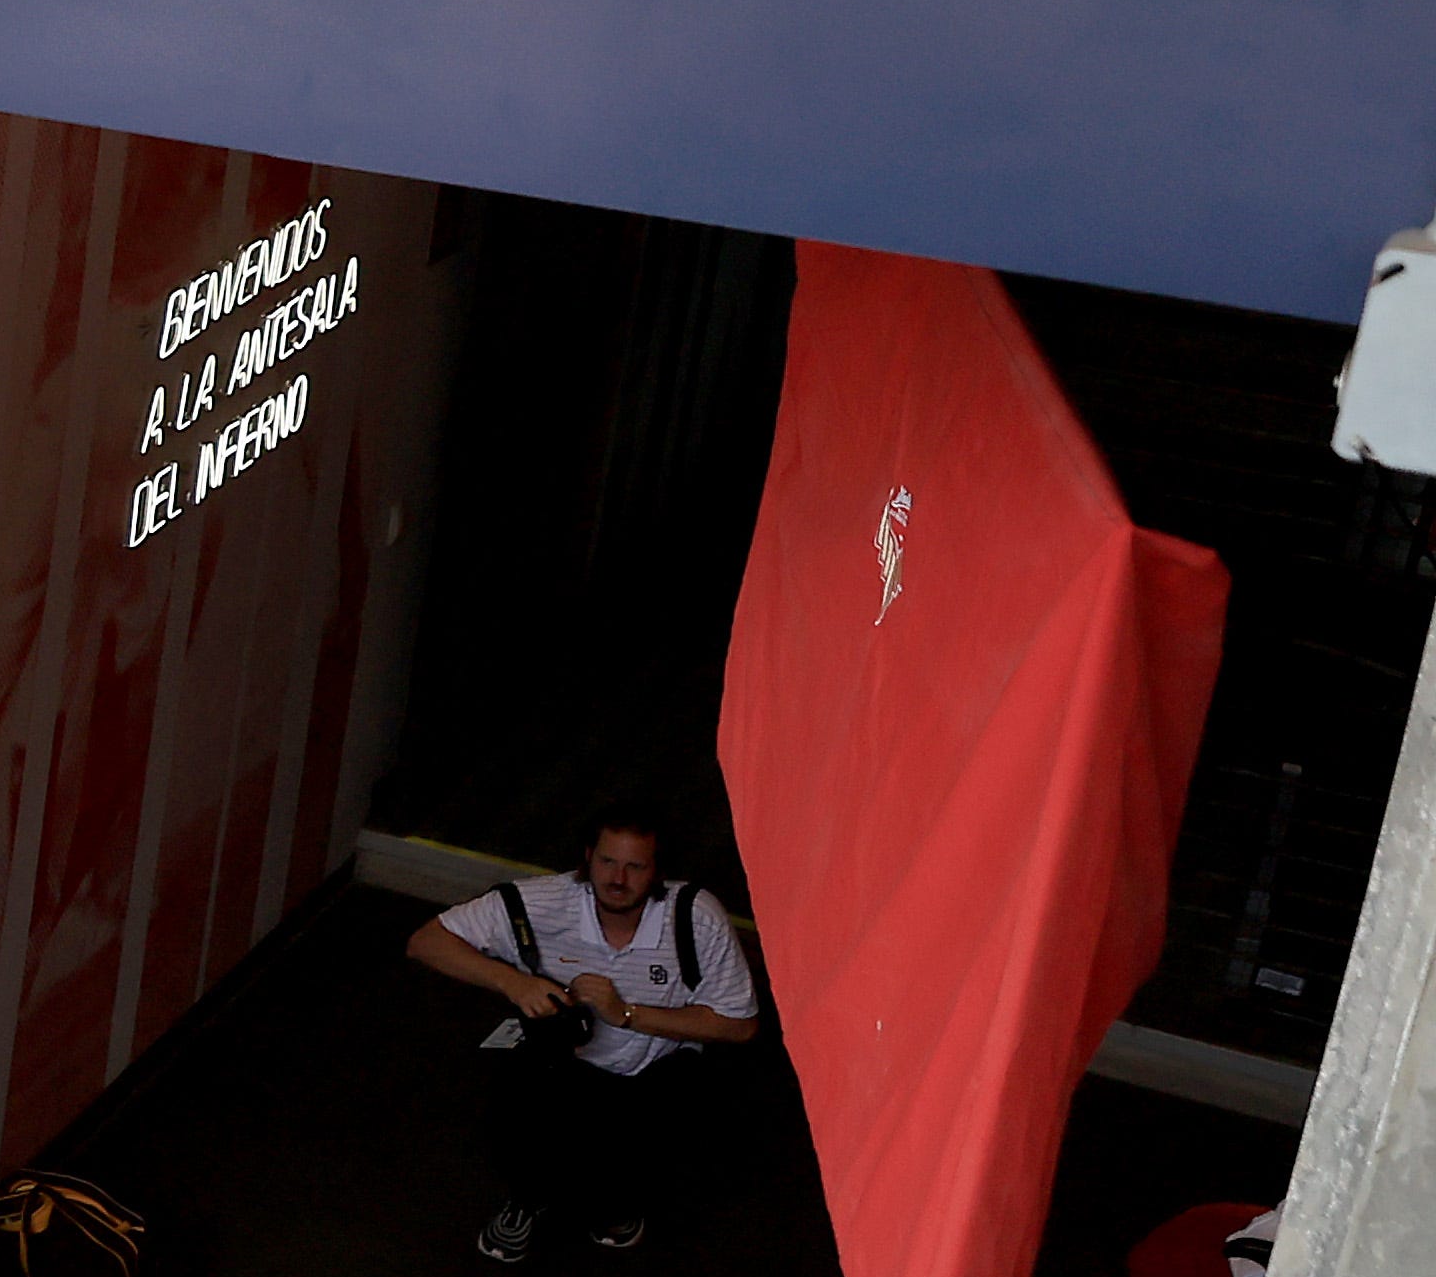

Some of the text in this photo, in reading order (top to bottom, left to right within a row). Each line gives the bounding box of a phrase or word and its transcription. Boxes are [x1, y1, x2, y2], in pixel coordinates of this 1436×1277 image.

[141, 256, 359, 454] A LA ANTESALA
[158, 199, 330, 359] BIENVENIDOS
[128, 375, 309, 548] DEL INFIERNO
